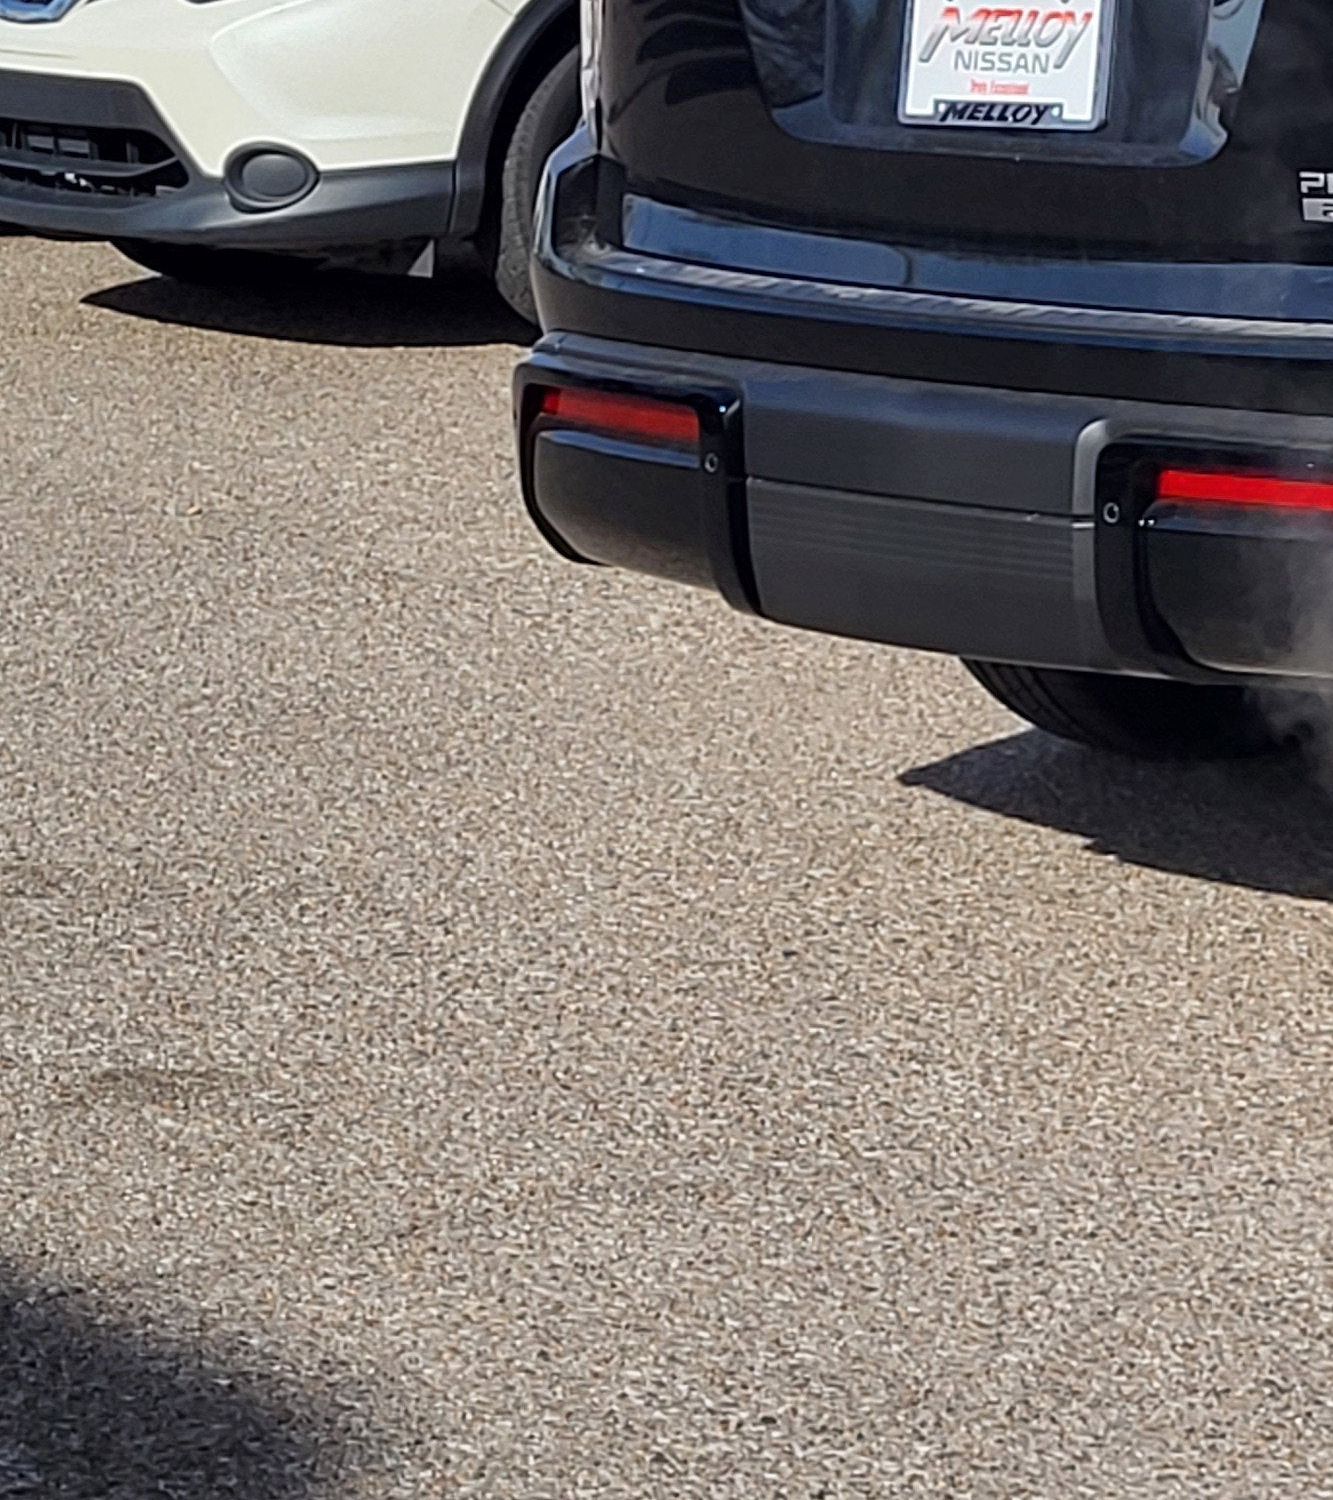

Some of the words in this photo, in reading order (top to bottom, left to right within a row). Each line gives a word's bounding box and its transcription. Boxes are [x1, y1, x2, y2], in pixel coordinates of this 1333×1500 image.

[918, 6, 1093, 70] MELLOY
[953, 50, 1050, 74] NISSAN
[938, 102, 1050, 126] MELLOY
